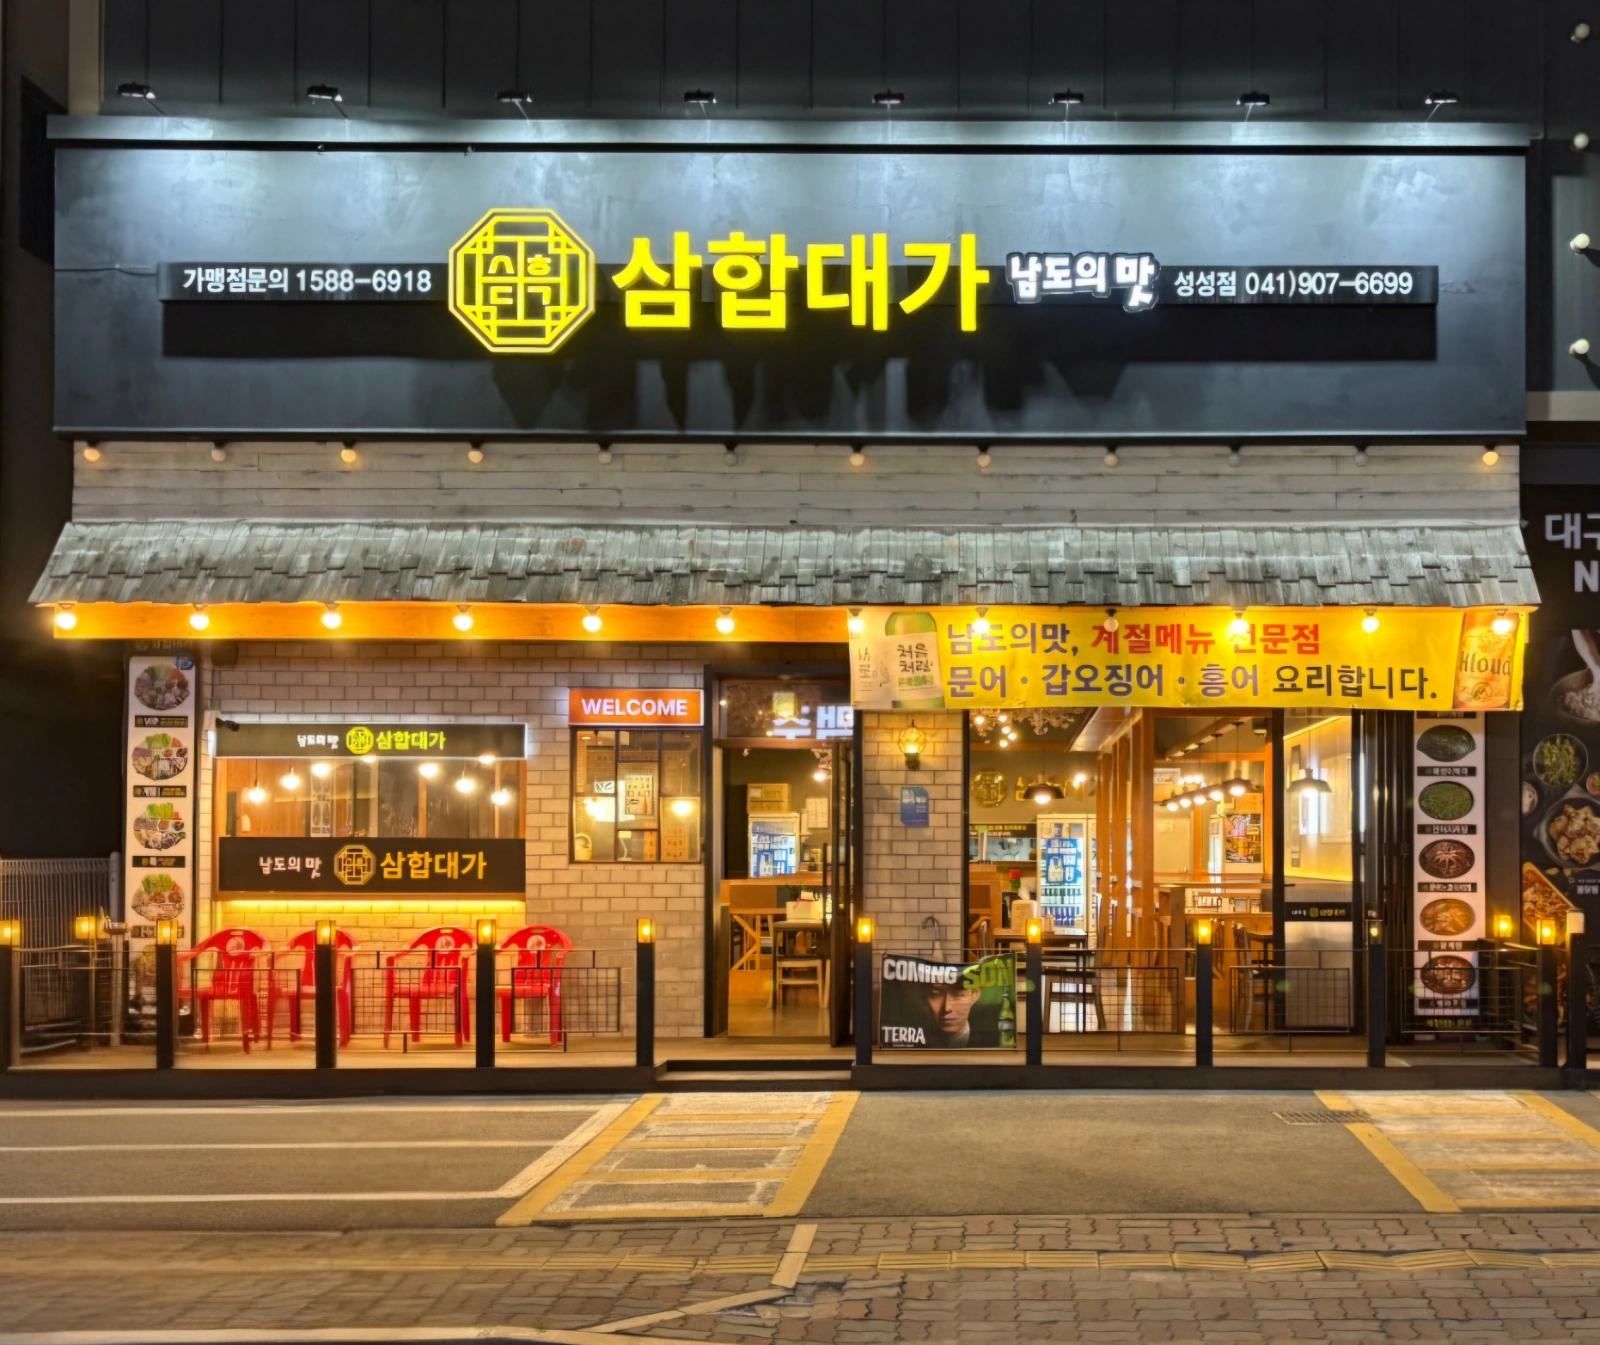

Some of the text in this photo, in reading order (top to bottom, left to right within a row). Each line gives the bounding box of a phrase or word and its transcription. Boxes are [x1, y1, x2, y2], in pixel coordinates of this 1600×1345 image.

[183, 268, 432, 293] 가맹점문의 1588-6918
[611, 231, 990, 332] 삼합대가
[1010, 255, 1155, 307] 남도의 맛
[1174, 271, 1413, 297] 성성점 041)907-6699
[1090, 623, 1216, 655] 계절메뉴
[947, 665, 1007, 698] 문어
[1041, 663, 1164, 697] 갑오징어
[1272, 664, 1438, 700] 요리합니다.
[581, 698, 689, 717] WELCOME
[376, 730, 447, 751] 삼합대가
[259, 856, 323, 880] 남도의 맛
[380, 851, 488, 880] 삼합대가
[883, 958, 959, 985] COMING
[881, 1026, 926, 1045] TERRA
